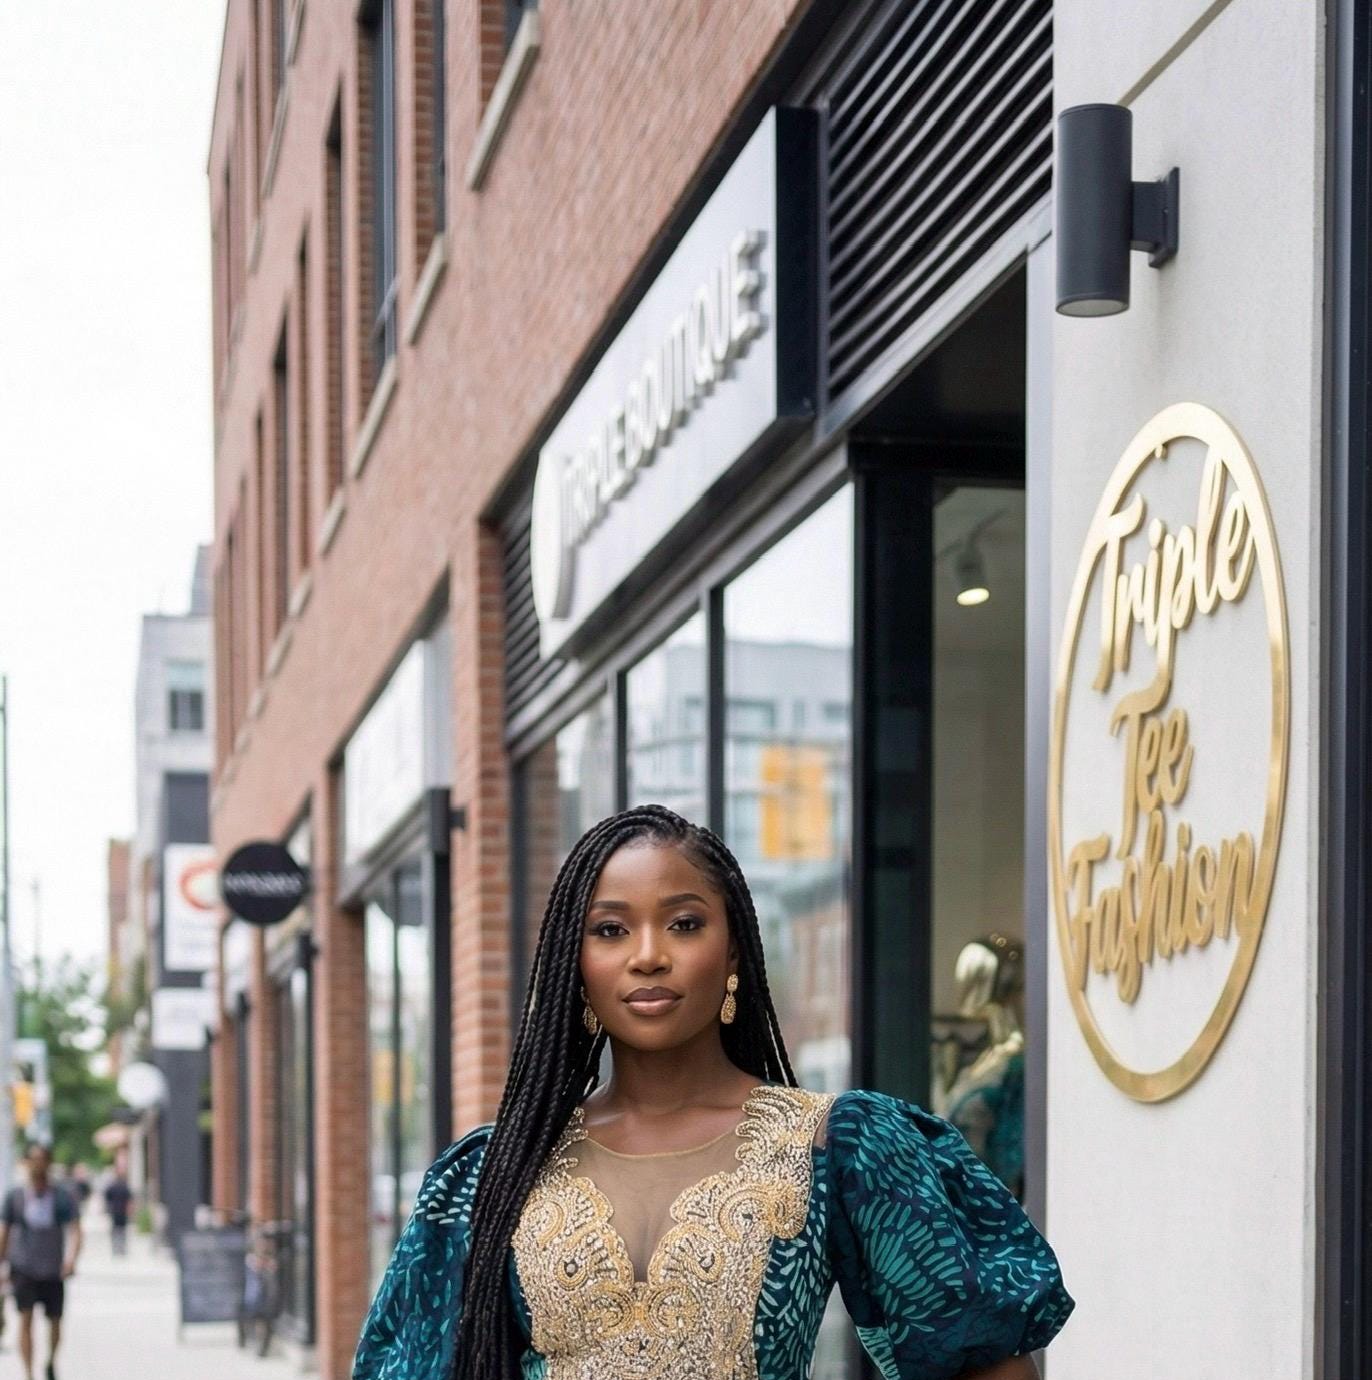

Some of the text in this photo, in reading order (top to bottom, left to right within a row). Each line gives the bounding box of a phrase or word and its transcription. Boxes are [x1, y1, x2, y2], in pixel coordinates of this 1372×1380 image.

[624, 229, 767, 470] BOUTIQUE
[1092, 446, 1257, 693] Triple
[1111, 688, 1193, 859] Tee
[1065, 810, 1256, 1004] Fashion
